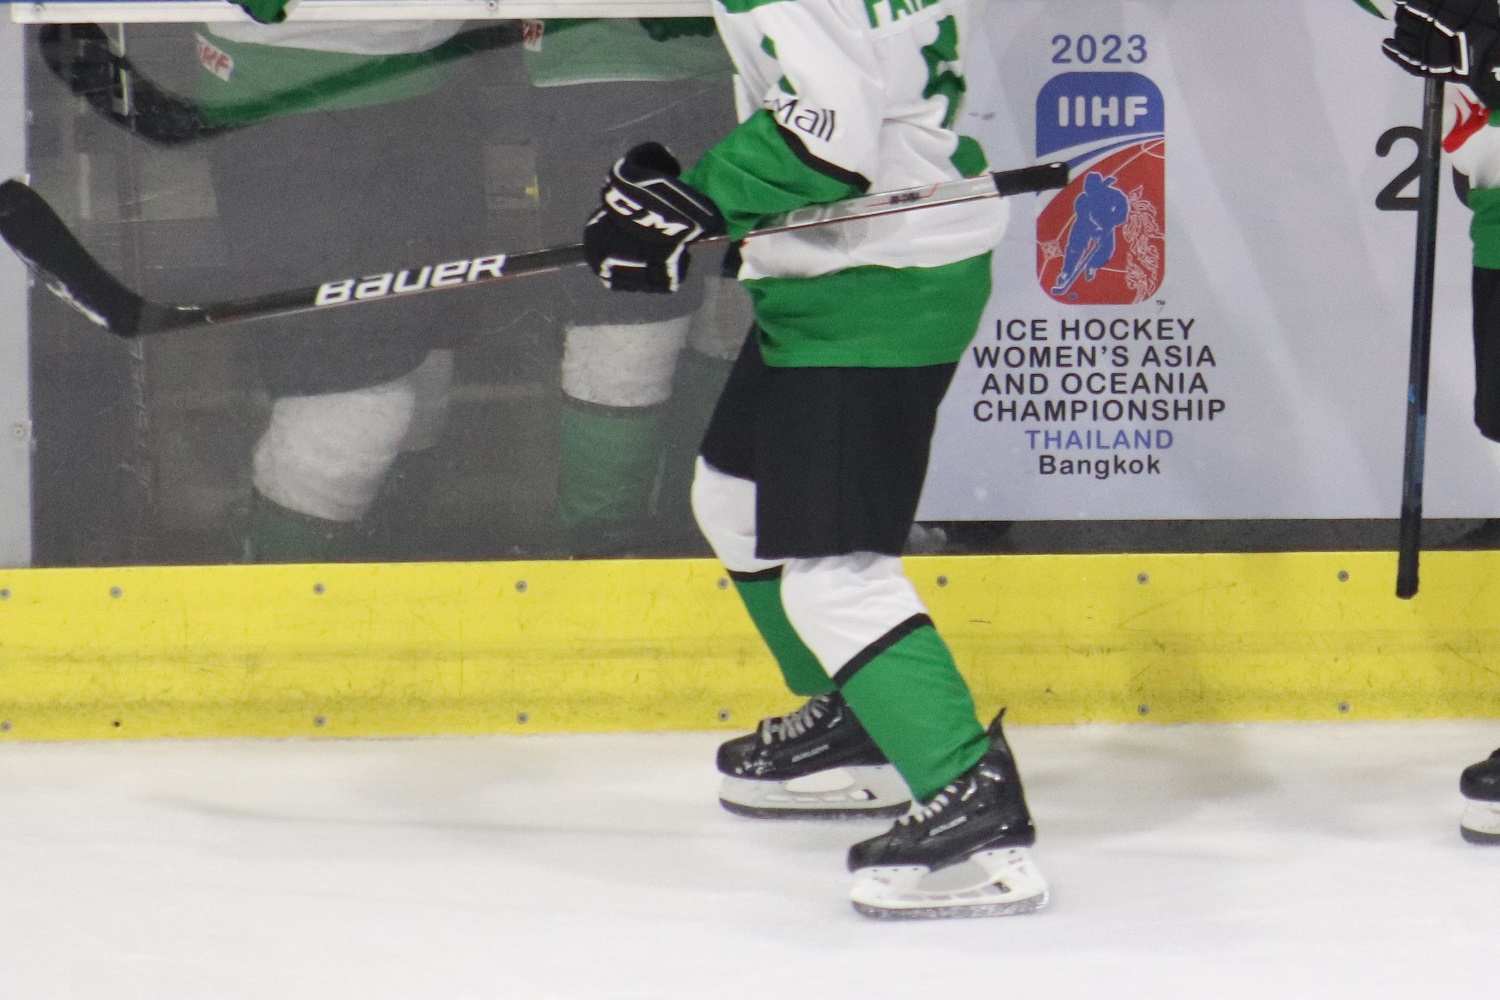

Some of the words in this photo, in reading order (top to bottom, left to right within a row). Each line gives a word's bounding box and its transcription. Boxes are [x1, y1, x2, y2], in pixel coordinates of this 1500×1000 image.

[1051, 34, 1148, 64] 2023
[1058, 96, 1148, 127] IIHF
[314, 253, 507, 306] BAUER
[996, 319, 1048, 341] ICE
[1060, 318, 1195, 341] HOCKEY
[1141, 345, 1216, 367] ASIA
[981, 373, 1049, 395] AND
[1061, 372, 1208, 394] OCEANIA
[973, 399, 1226, 422] CHAMPIONSHIP
[1025, 429, 1174, 450] THAILAND
[1039, 454, 1160, 479] Bangkok
